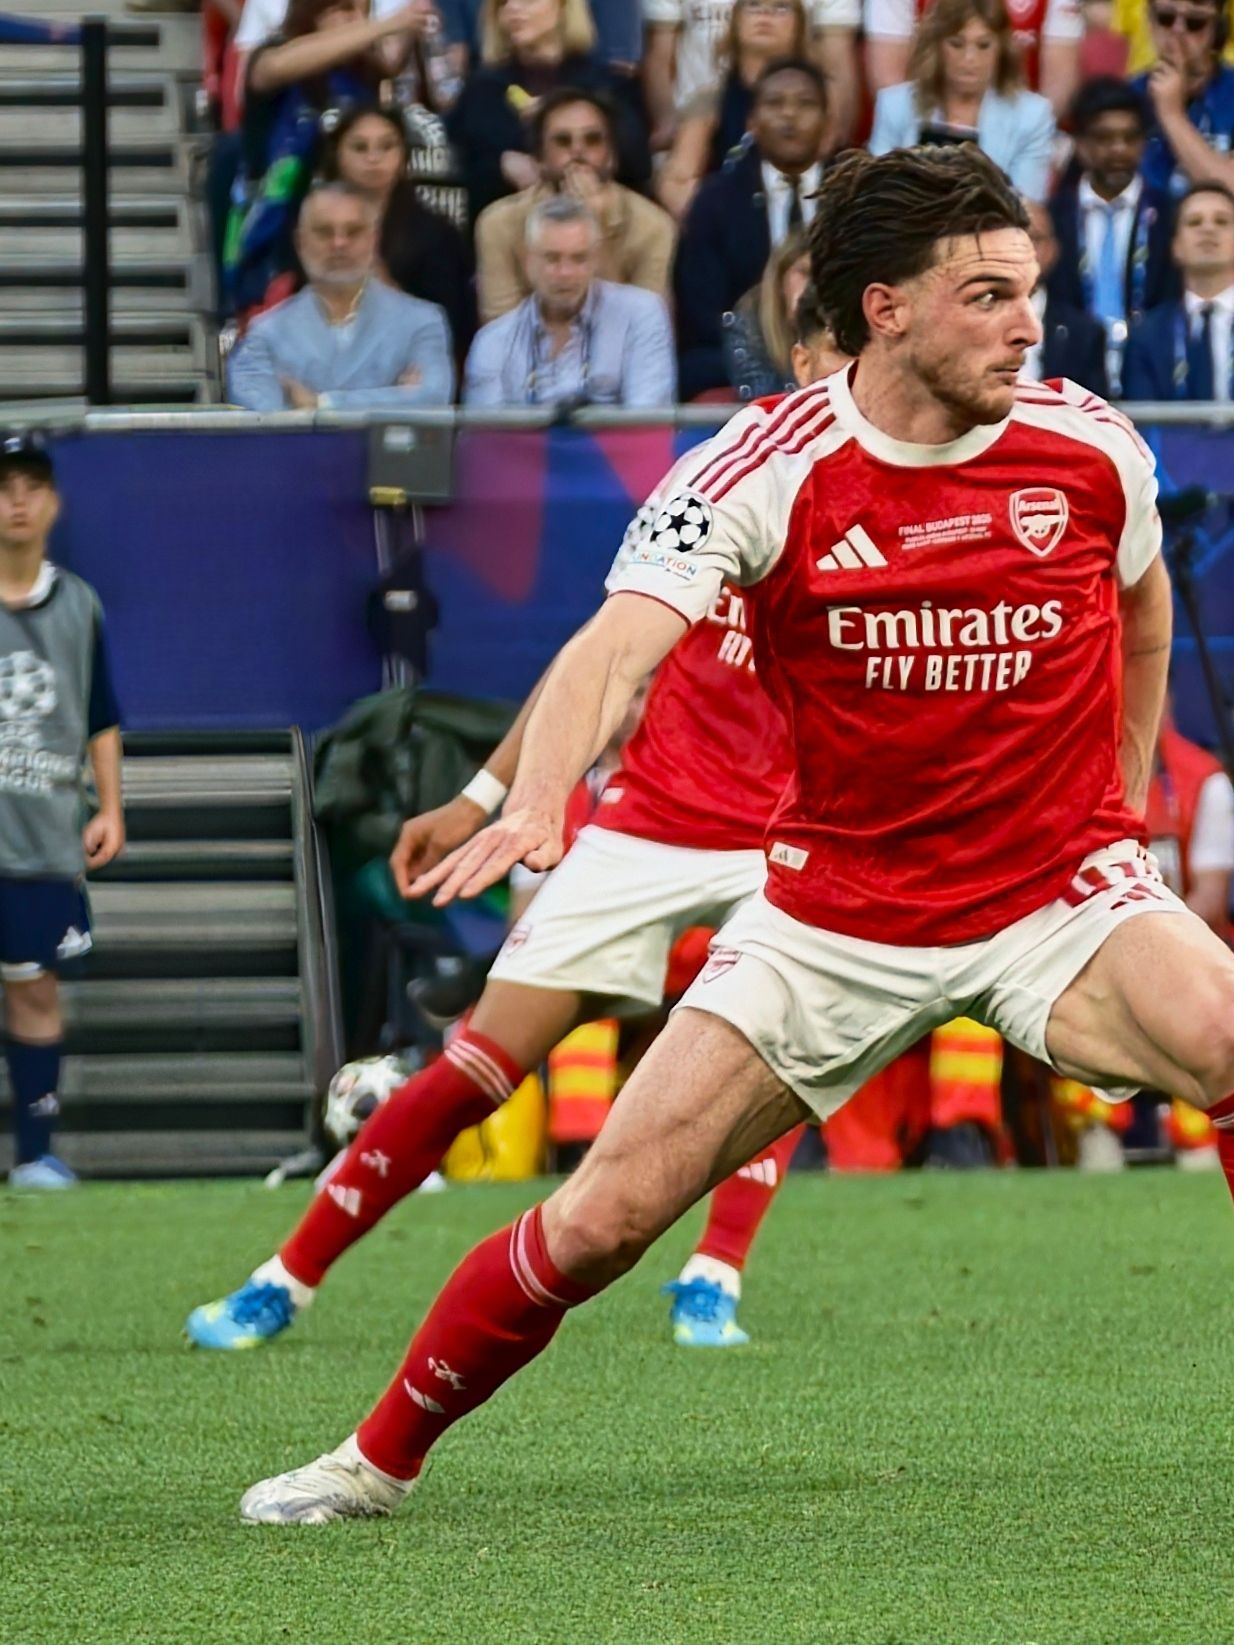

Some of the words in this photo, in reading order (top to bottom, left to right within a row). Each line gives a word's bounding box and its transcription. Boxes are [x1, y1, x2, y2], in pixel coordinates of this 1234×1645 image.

[1018, 500, 1061, 511] Arsenal
[898, 524, 925, 537] FINAL
[925, 514, 971, 533] BUDAPEST
[826, 599, 1062, 651] Emirates
[865, 655, 915, 691] FLY
[924, 649, 1033, 692] BETTER
